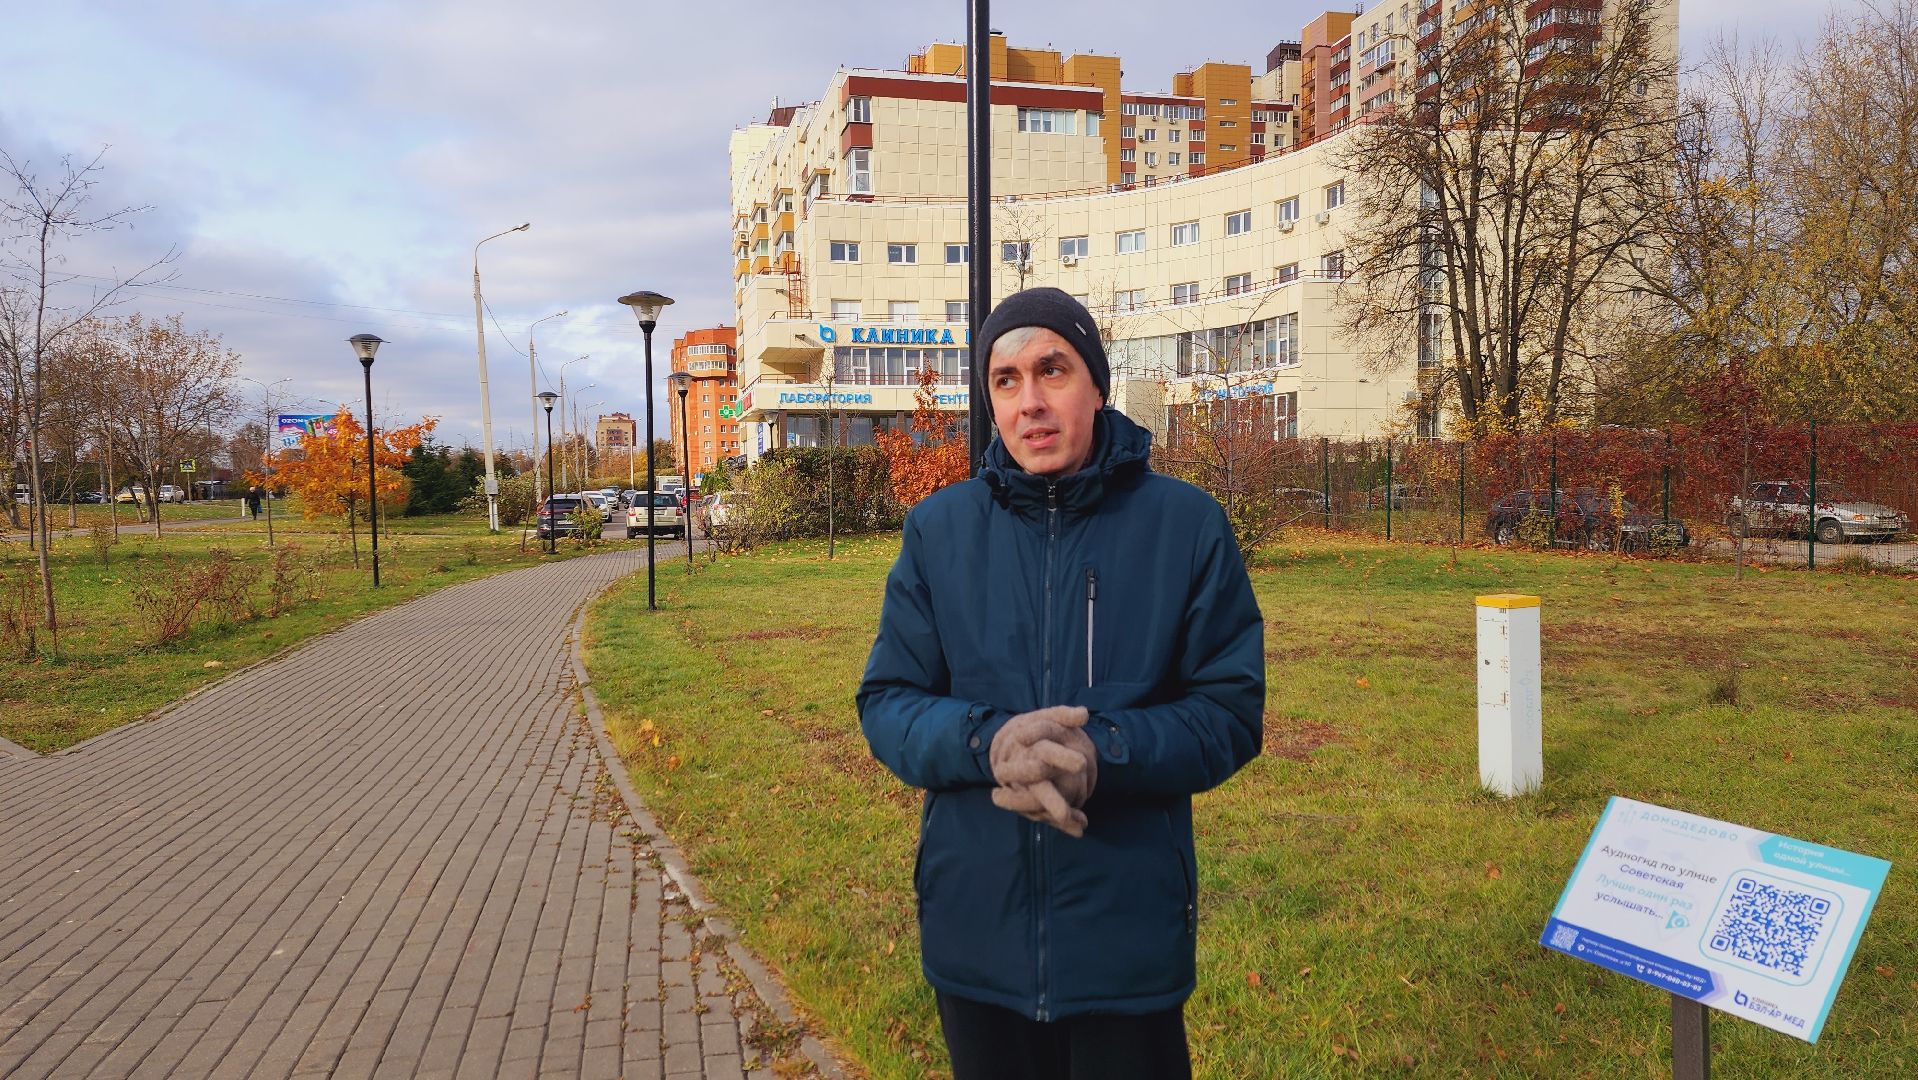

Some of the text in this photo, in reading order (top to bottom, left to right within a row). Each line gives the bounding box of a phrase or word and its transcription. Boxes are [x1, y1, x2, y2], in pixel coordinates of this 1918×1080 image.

[851, 327, 955, 344] КЛИНИКА
[780, 392, 873, 404] ЛАБОРАТОРИЯ
[1640, 811, 1739, 841] ДОМОДЕДОВО
[1778, 841, 1825, 858] История
[1601, 845, 1718, 885] Аудиогид по улице
[1773, 852, 1807, 866] одной
[1620, 864, 1684, 889] Советская
[1596, 873, 1693, 910] Лучше один раз
[1783, 1013, 1806, 1030] МЕД
